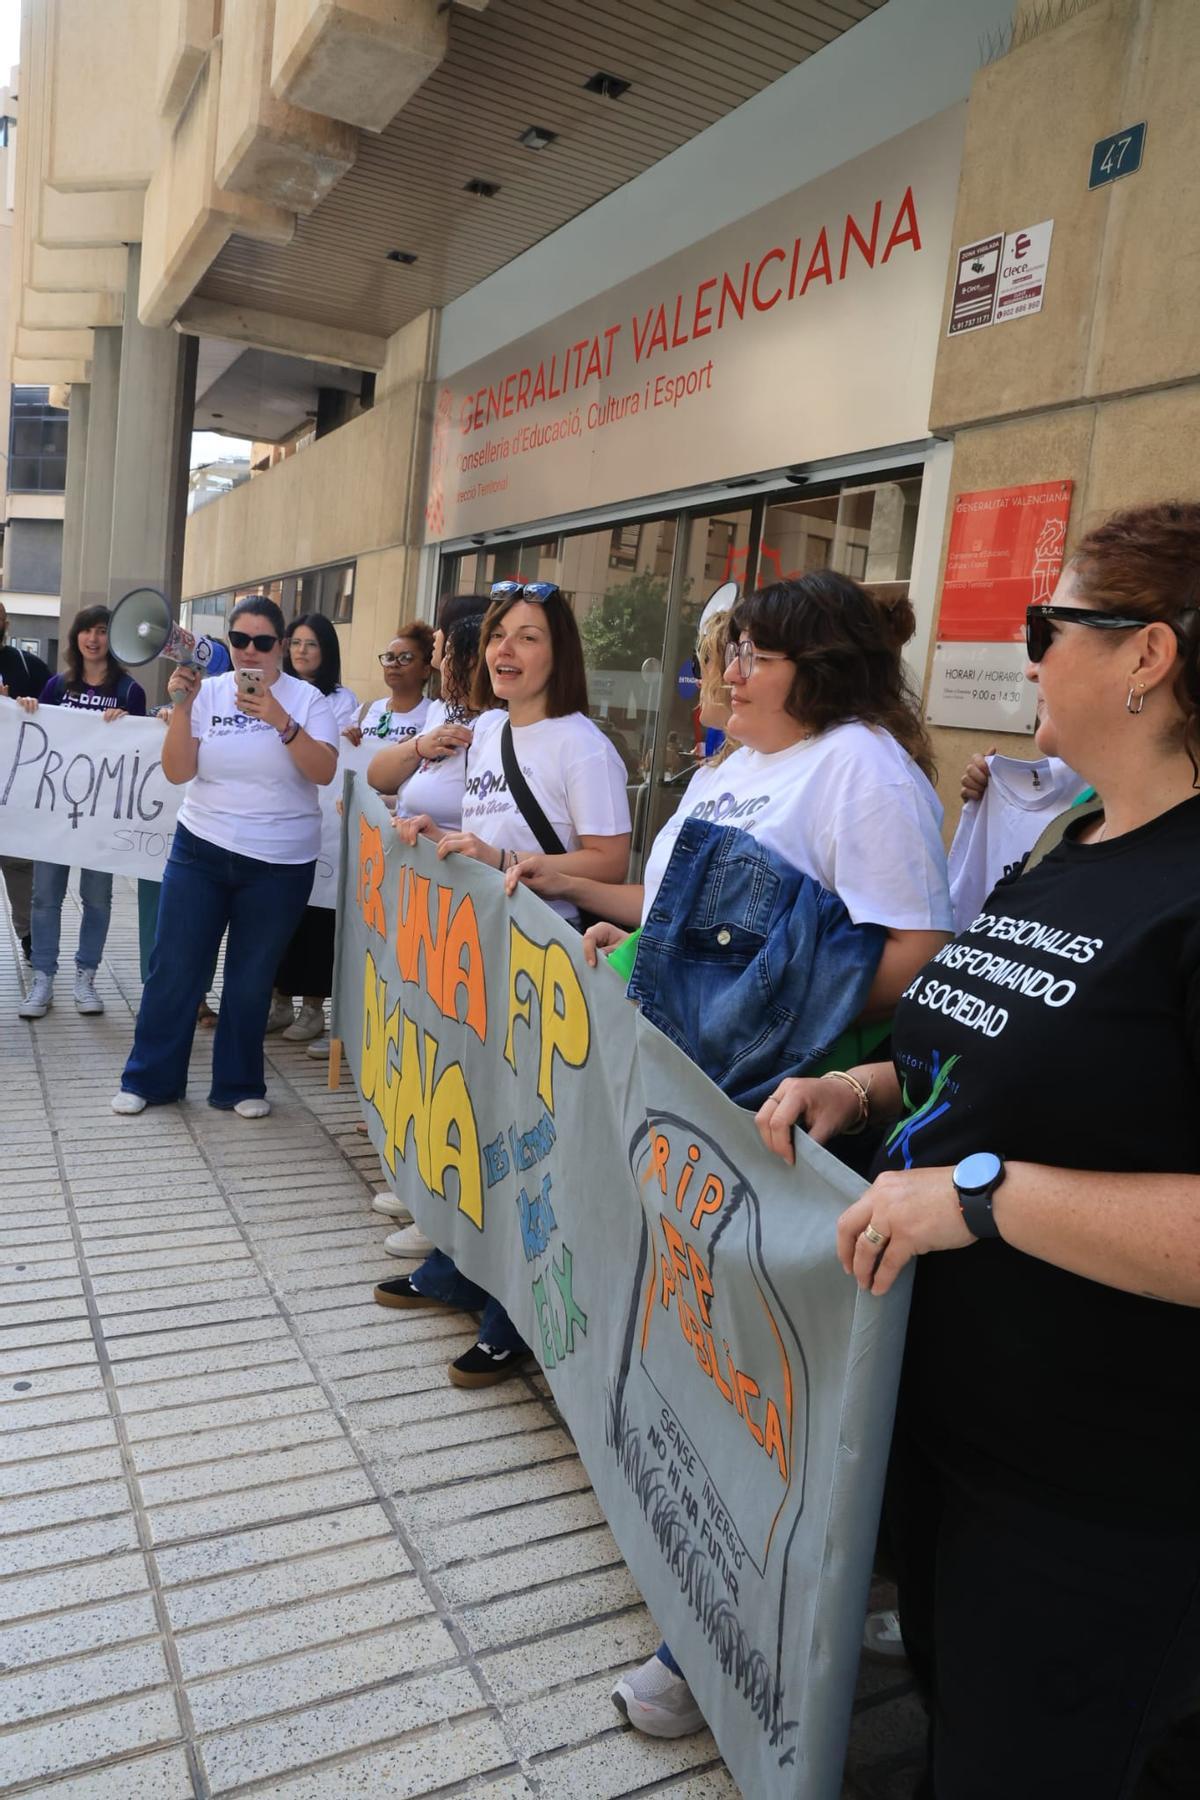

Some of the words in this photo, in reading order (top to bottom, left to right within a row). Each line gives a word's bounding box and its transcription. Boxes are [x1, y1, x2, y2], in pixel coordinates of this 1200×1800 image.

[1100, 136, 1132, 174] 47
[1003, 263, 1029, 279] Clece
[460, 324, 621, 435] GENERALITAT
[632, 185, 922, 364] VALENCIANA
[587, 392, 640, 430] Cultura
[644, 381, 650, 410] i
[654, 359, 713, 408] Esport
[956, 498, 1009, 513] GENERALITAT
[1012, 493, 1067, 506] VALENCIANA
[945, 668, 976, 681] HORARI
[985, 671, 1024, 683] HORARIO
[363, 726, 417, 737] PRMIG
[396, 864, 487, 1045] UNA
[504, 917, 591, 1116] FP
[918, 979, 1009, 1038] SOCIEDAD
[360, 949, 485, 1232] DIGNA
[660, 1408, 697, 1478] SENSE
[647, 1424, 667, 1461] NO
[681, 1485, 698, 1528] HA
[700, 1518, 740, 1607] FUTUR
